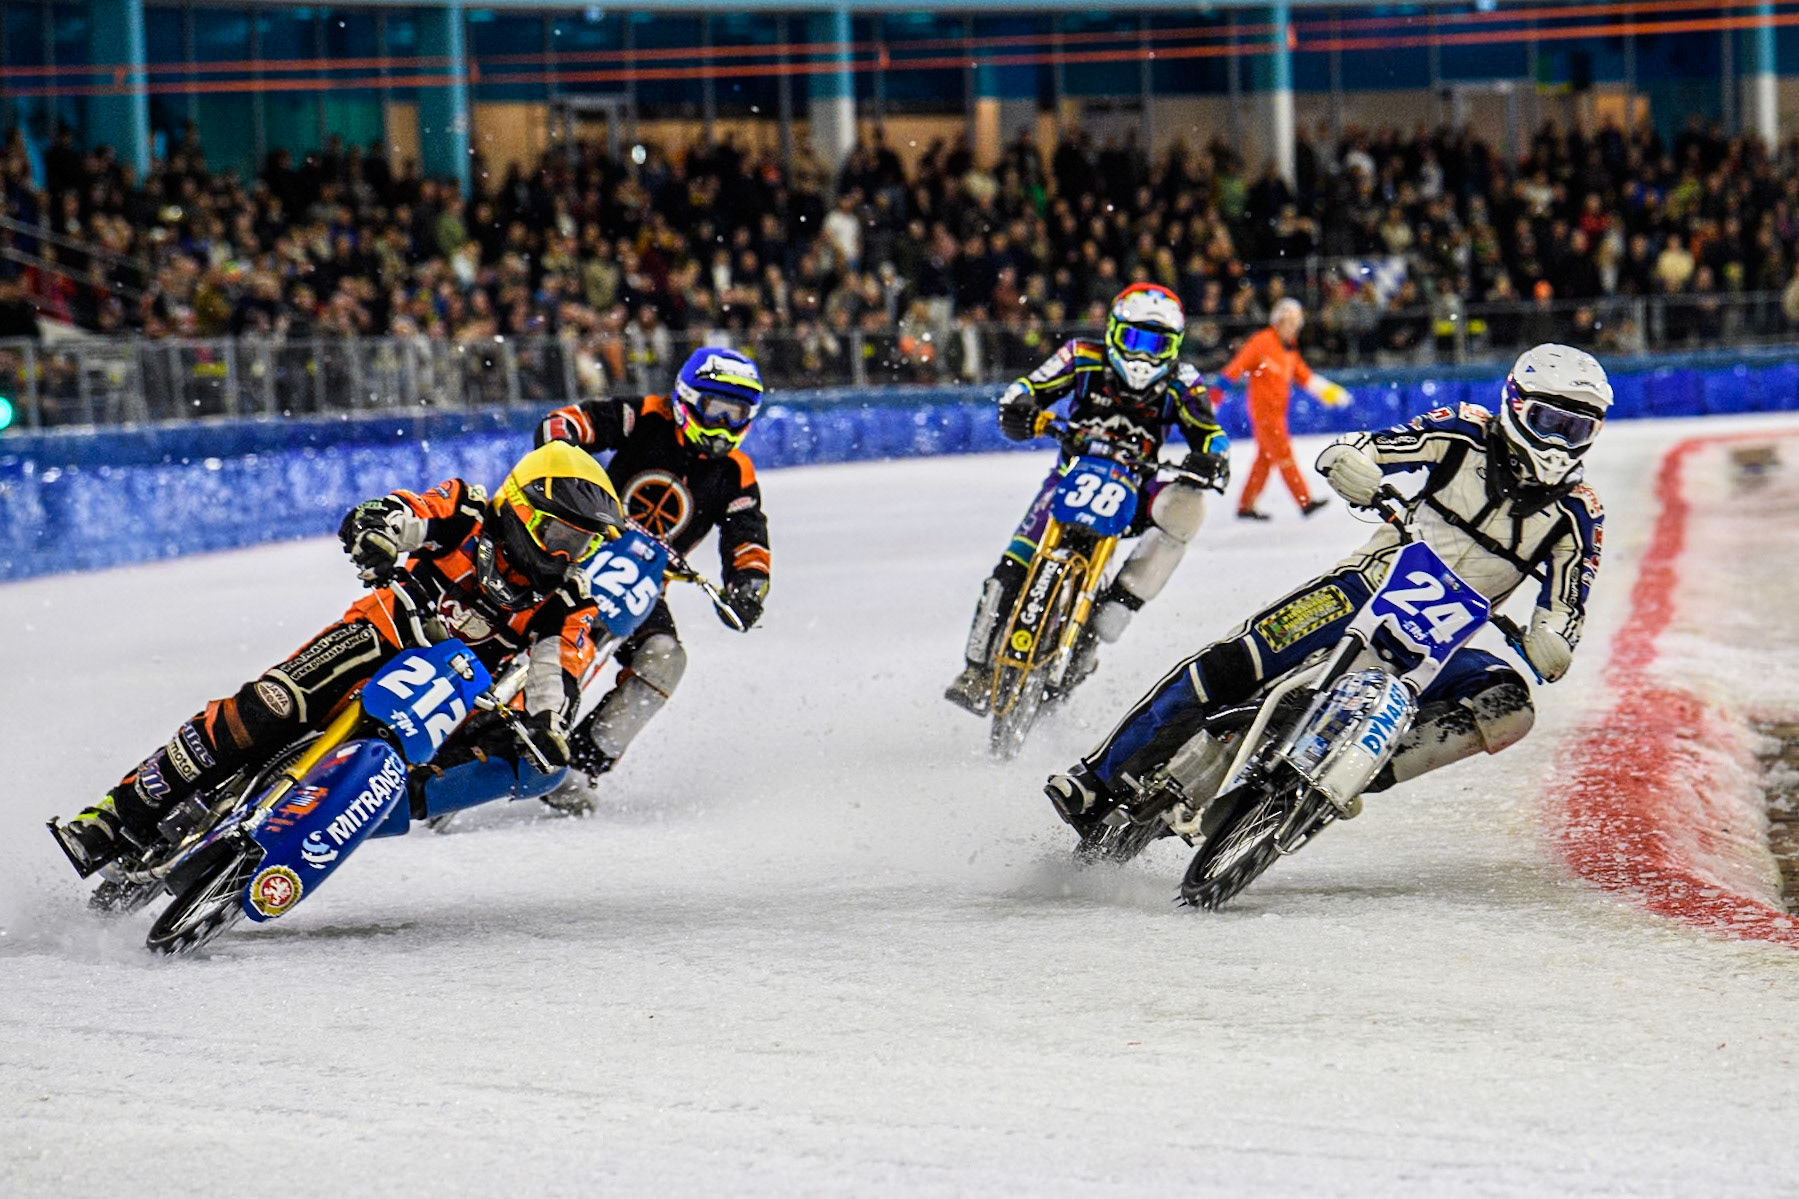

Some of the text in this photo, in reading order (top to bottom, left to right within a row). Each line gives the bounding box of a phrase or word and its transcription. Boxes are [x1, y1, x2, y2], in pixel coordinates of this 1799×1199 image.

[1064, 473, 1126, 518] 38
[585, 550, 659, 616] 125
[1381, 571, 1475, 644] 24
[265, 683, 290, 708] JAWA
[377, 655, 467, 749] 212
